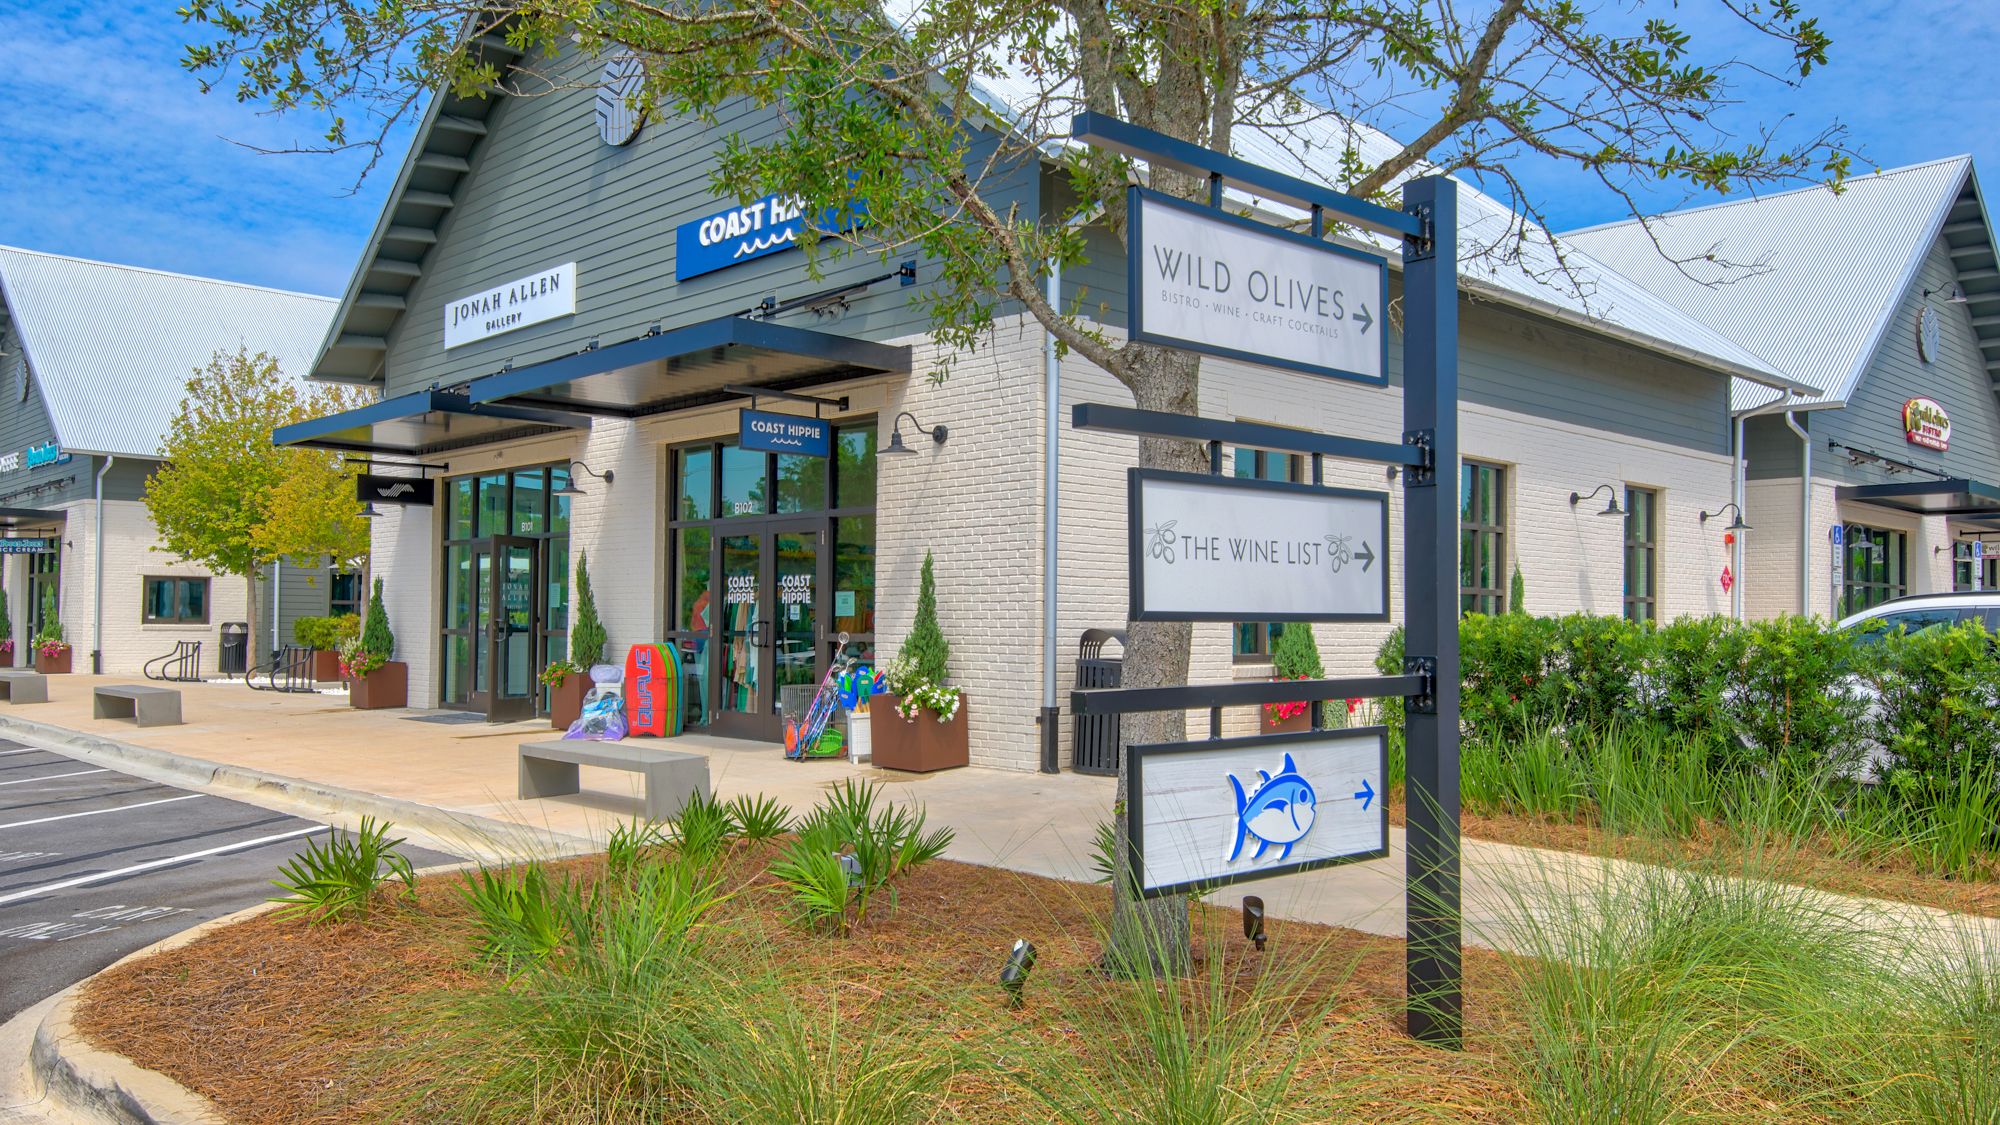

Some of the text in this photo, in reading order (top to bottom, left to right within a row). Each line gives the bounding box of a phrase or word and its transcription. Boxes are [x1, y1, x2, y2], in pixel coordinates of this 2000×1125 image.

[699, 202, 765, 246] COAST
[1153, 245, 1344, 321] WILD OLIVES
[453, 274, 560, 326] JONAH ALLEN
[486, 312, 522, 331] GALLERY
[1161, 290, 1339, 339] BISTRO WINE CRAFT COCKTAILS
[751, 420, 820, 439] COAST HIPPIE
[734, 501, 753, 514] B102
[521, 522, 533, 532] B101
[1181, 535, 1322, 565] THE WINE LIST
[728, 576, 755, 588] COAST
[782, 575, 811, 588] COAST
[727, 592, 755, 604] HIPPIE
[781, 592, 812, 604] HIPPIE
